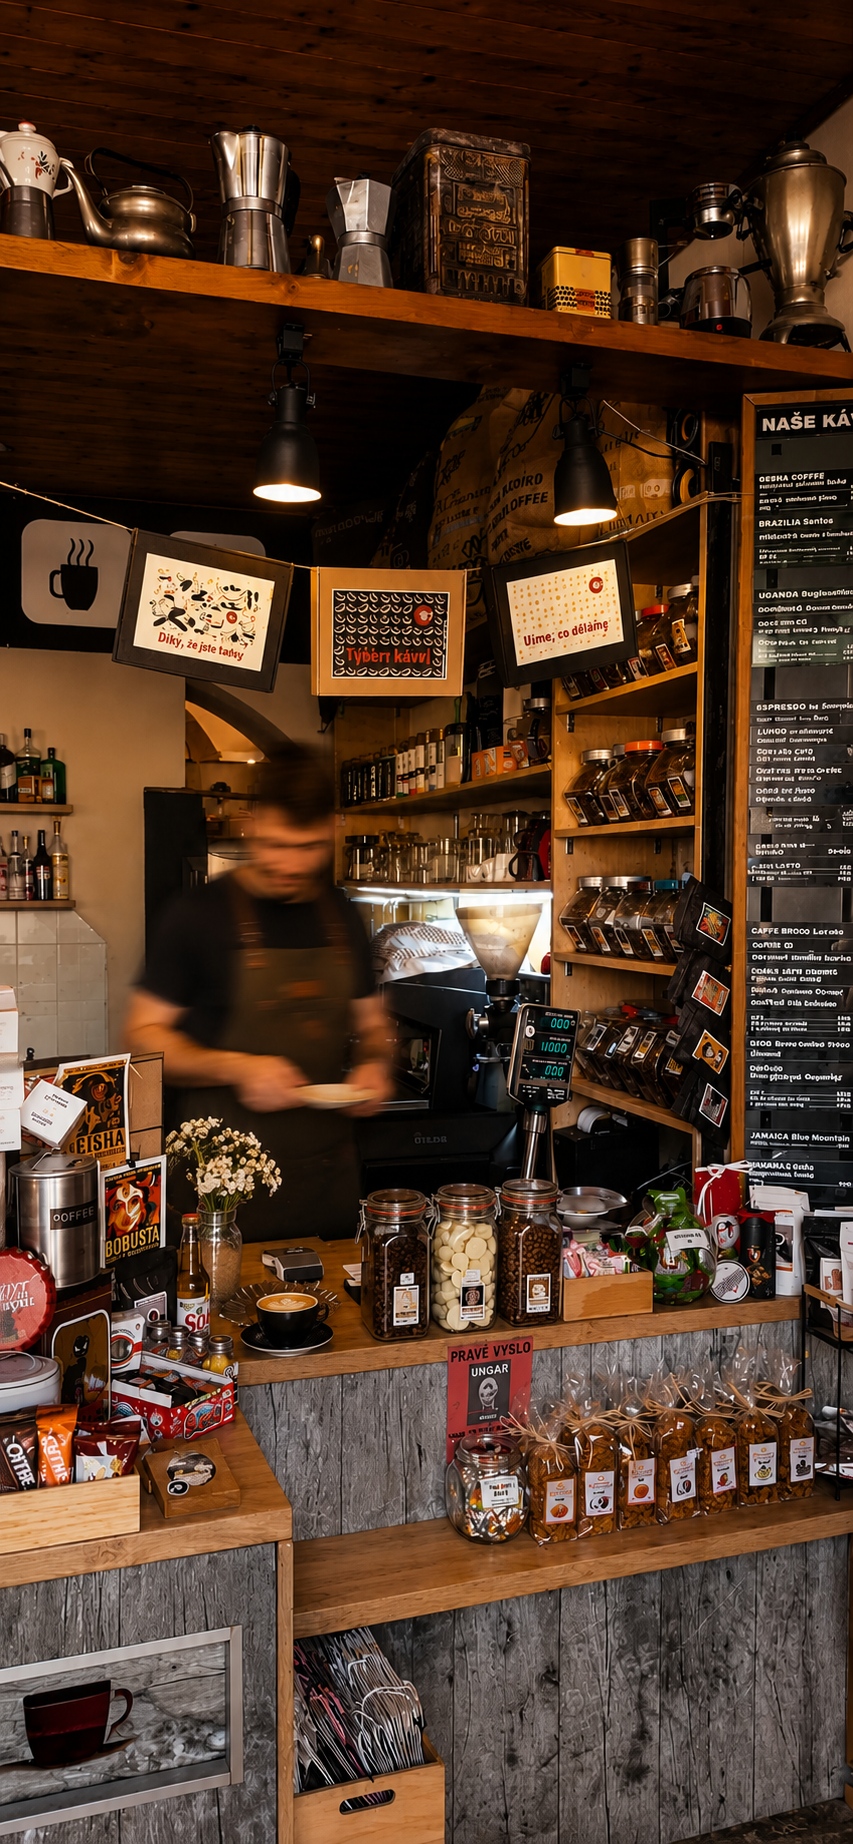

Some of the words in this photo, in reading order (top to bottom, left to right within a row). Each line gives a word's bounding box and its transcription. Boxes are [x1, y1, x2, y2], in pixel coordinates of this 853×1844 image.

[762, 411, 816, 431] NAŠE
[823, 408, 853, 428] KÁ
[758, 518, 801, 528] BRAZILIA
[557, 629, 570, 639] co
[198, 641, 217, 654] jste
[550, 1017, 570, 1030] 000
[544, 1064, 564, 1077] 000
[750, 1132, 789, 1140] JAMAICA
[811, 1134, 850, 1142] Mountain
[493, 1341, 531, 1357] VYSLO
[471, 1363, 509, 1377] UNGAR
